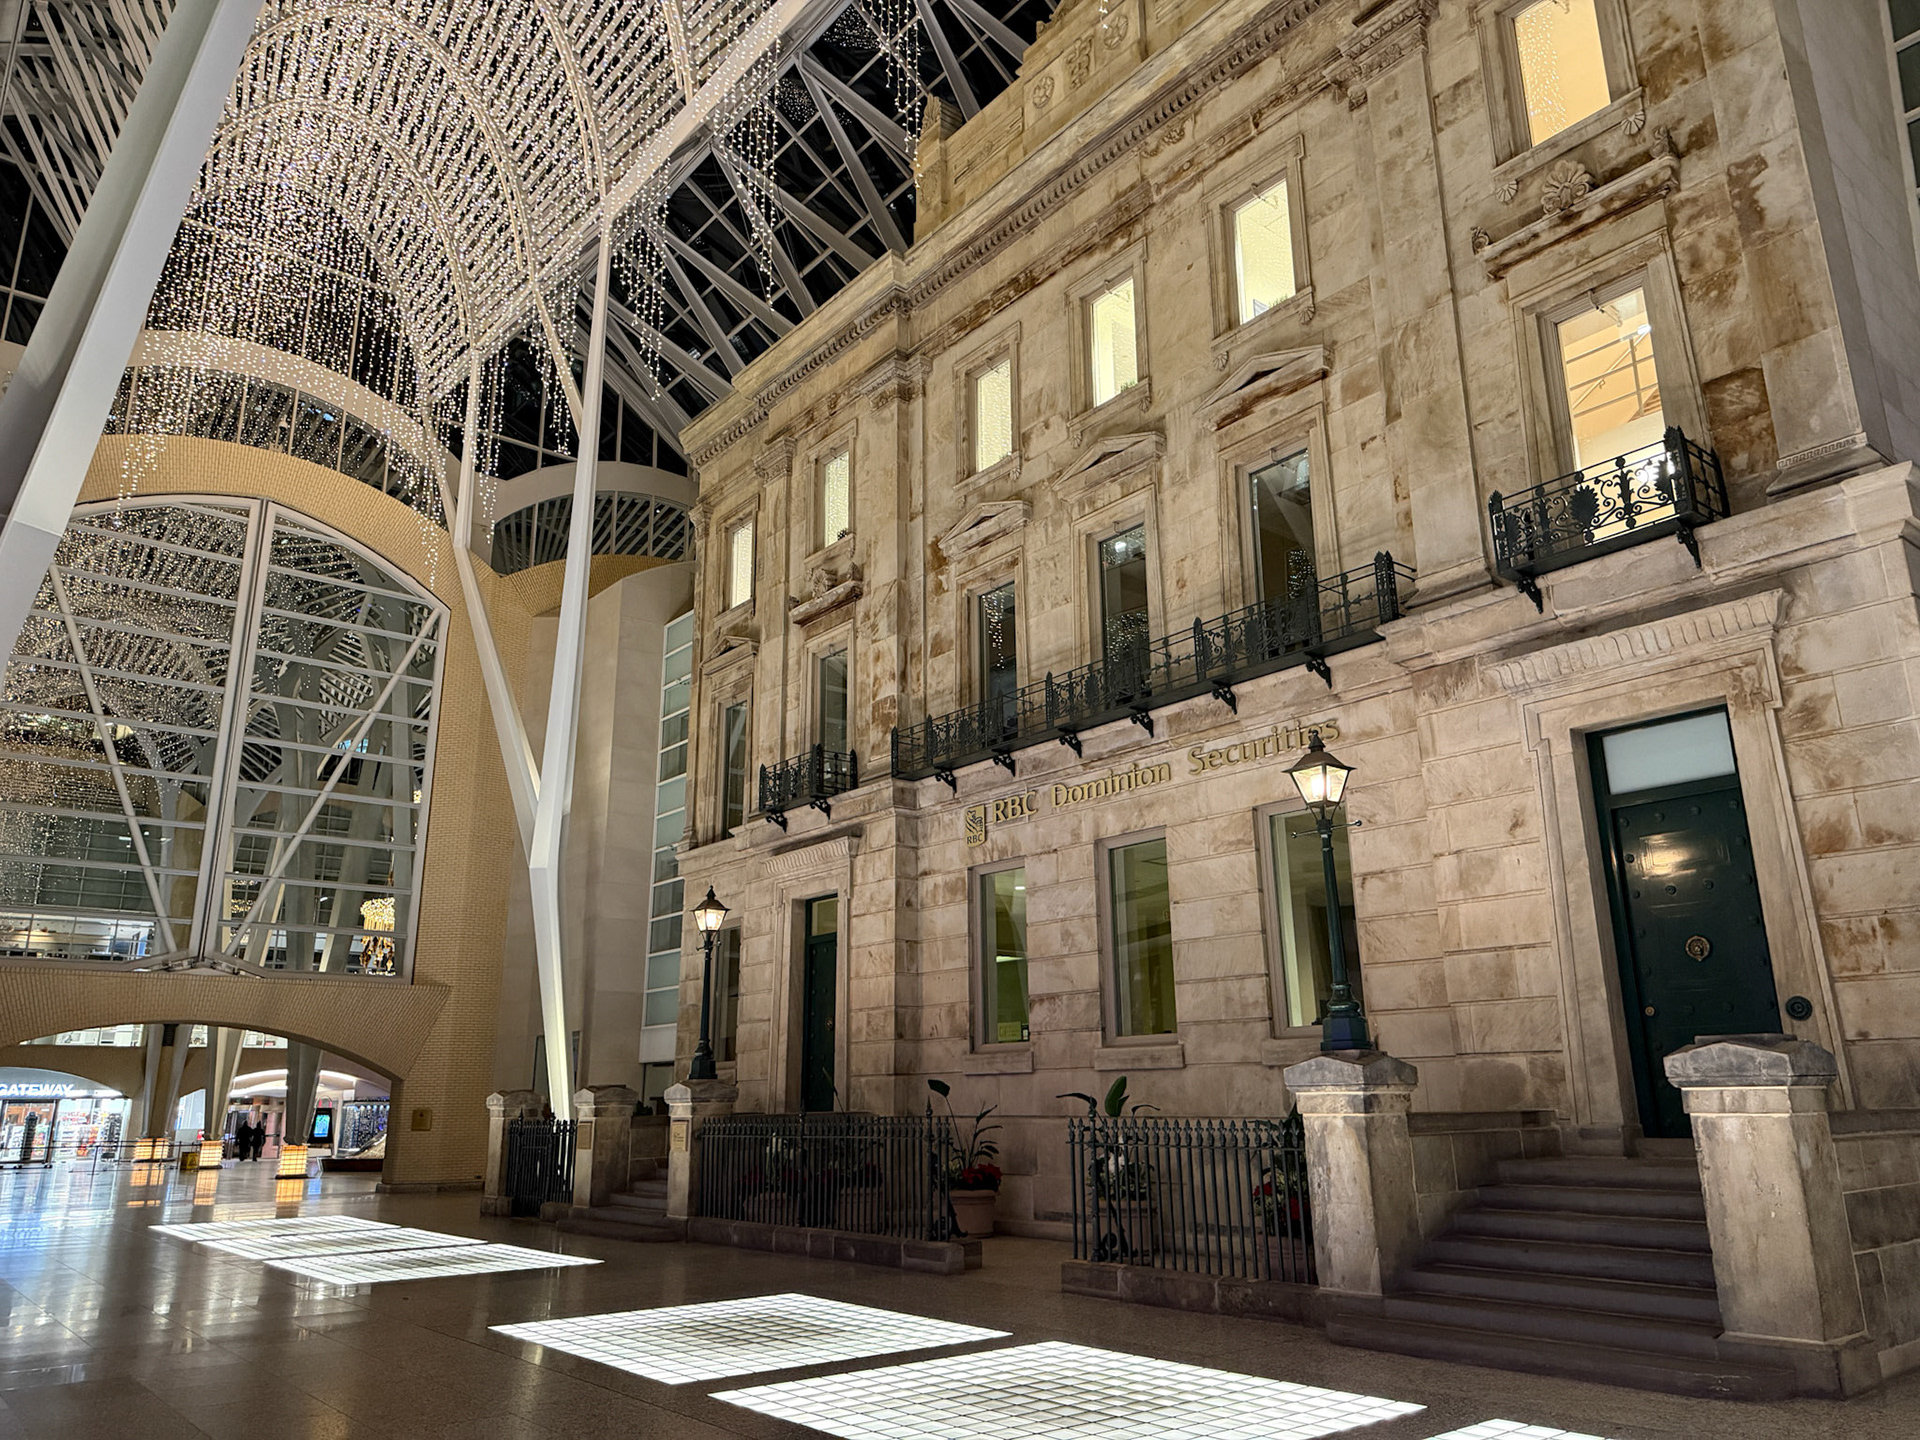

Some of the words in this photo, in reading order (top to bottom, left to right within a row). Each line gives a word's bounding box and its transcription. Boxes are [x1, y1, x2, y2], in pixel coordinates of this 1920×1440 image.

[992, 791, 1037, 824] RBC
[1051, 761, 1171, 808] Dominion
[966, 832, 983, 845] RBC
[0, 1083, 75, 1097] GATEWAY
